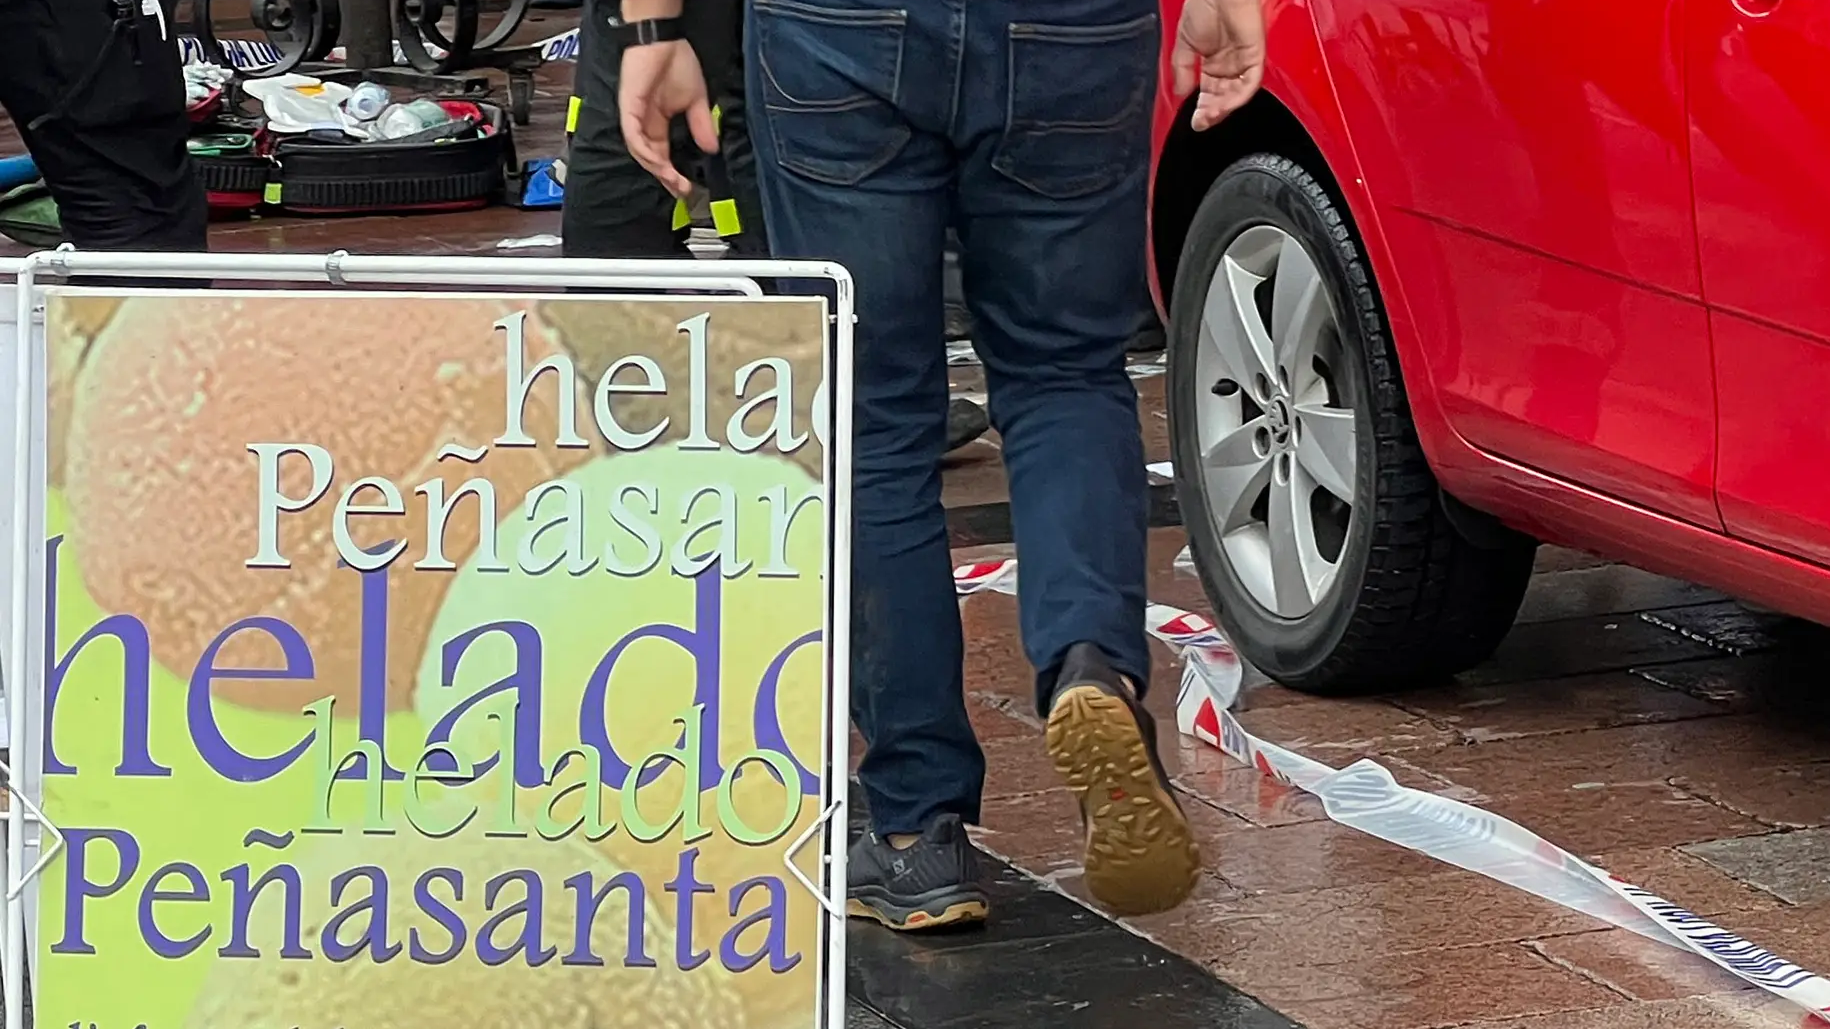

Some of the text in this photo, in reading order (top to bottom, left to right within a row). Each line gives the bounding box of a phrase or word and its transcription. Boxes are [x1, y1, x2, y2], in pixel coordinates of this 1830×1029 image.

[494, 311, 825, 453] hela
[301, 696, 803, 847] helado
[50, 827, 803, 973] Peñasanta
